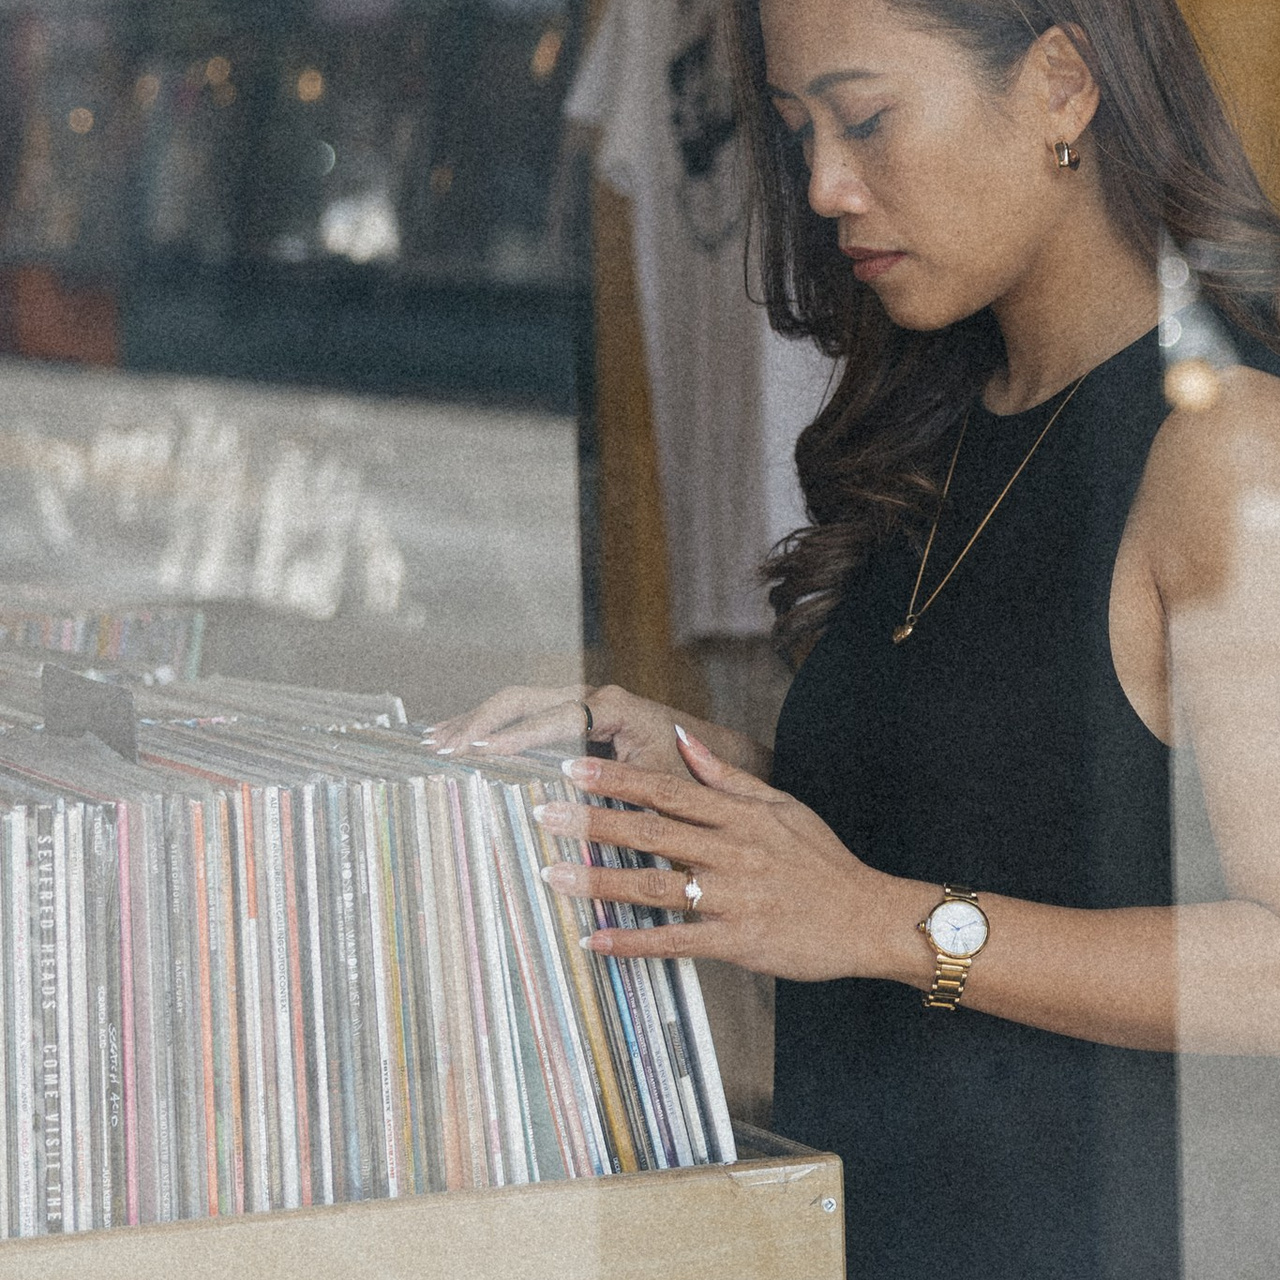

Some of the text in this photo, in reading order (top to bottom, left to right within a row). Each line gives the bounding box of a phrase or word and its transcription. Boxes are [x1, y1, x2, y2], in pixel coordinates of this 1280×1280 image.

[339, 822, 351, 861] GAVIN
[341, 862, 353, 922] ROSSDALE
[97, 986, 105, 1024] SCRATCH
[632, 1010, 642, 1033] MODERN
[37, 835, 61, 1222] SEVERED HEADS COME VISIT THE
[98, 1028, 106, 1049] ACID
[634, 974, 646, 1003] MODERN
[642, 1005, 653, 1033] LOVERS
[653, 1051, 661, 1068] BACK
[658, 1079, 668, 1098] YOUR
[665, 1099, 673, 1116] LIFE
[636, 1034, 647, 1055] LOVERS
[645, 1065, 657, 1098] JONATHAN
[101, 1167, 110, 1188] JUST
[102, 1189, 110, 1213] KEEP
